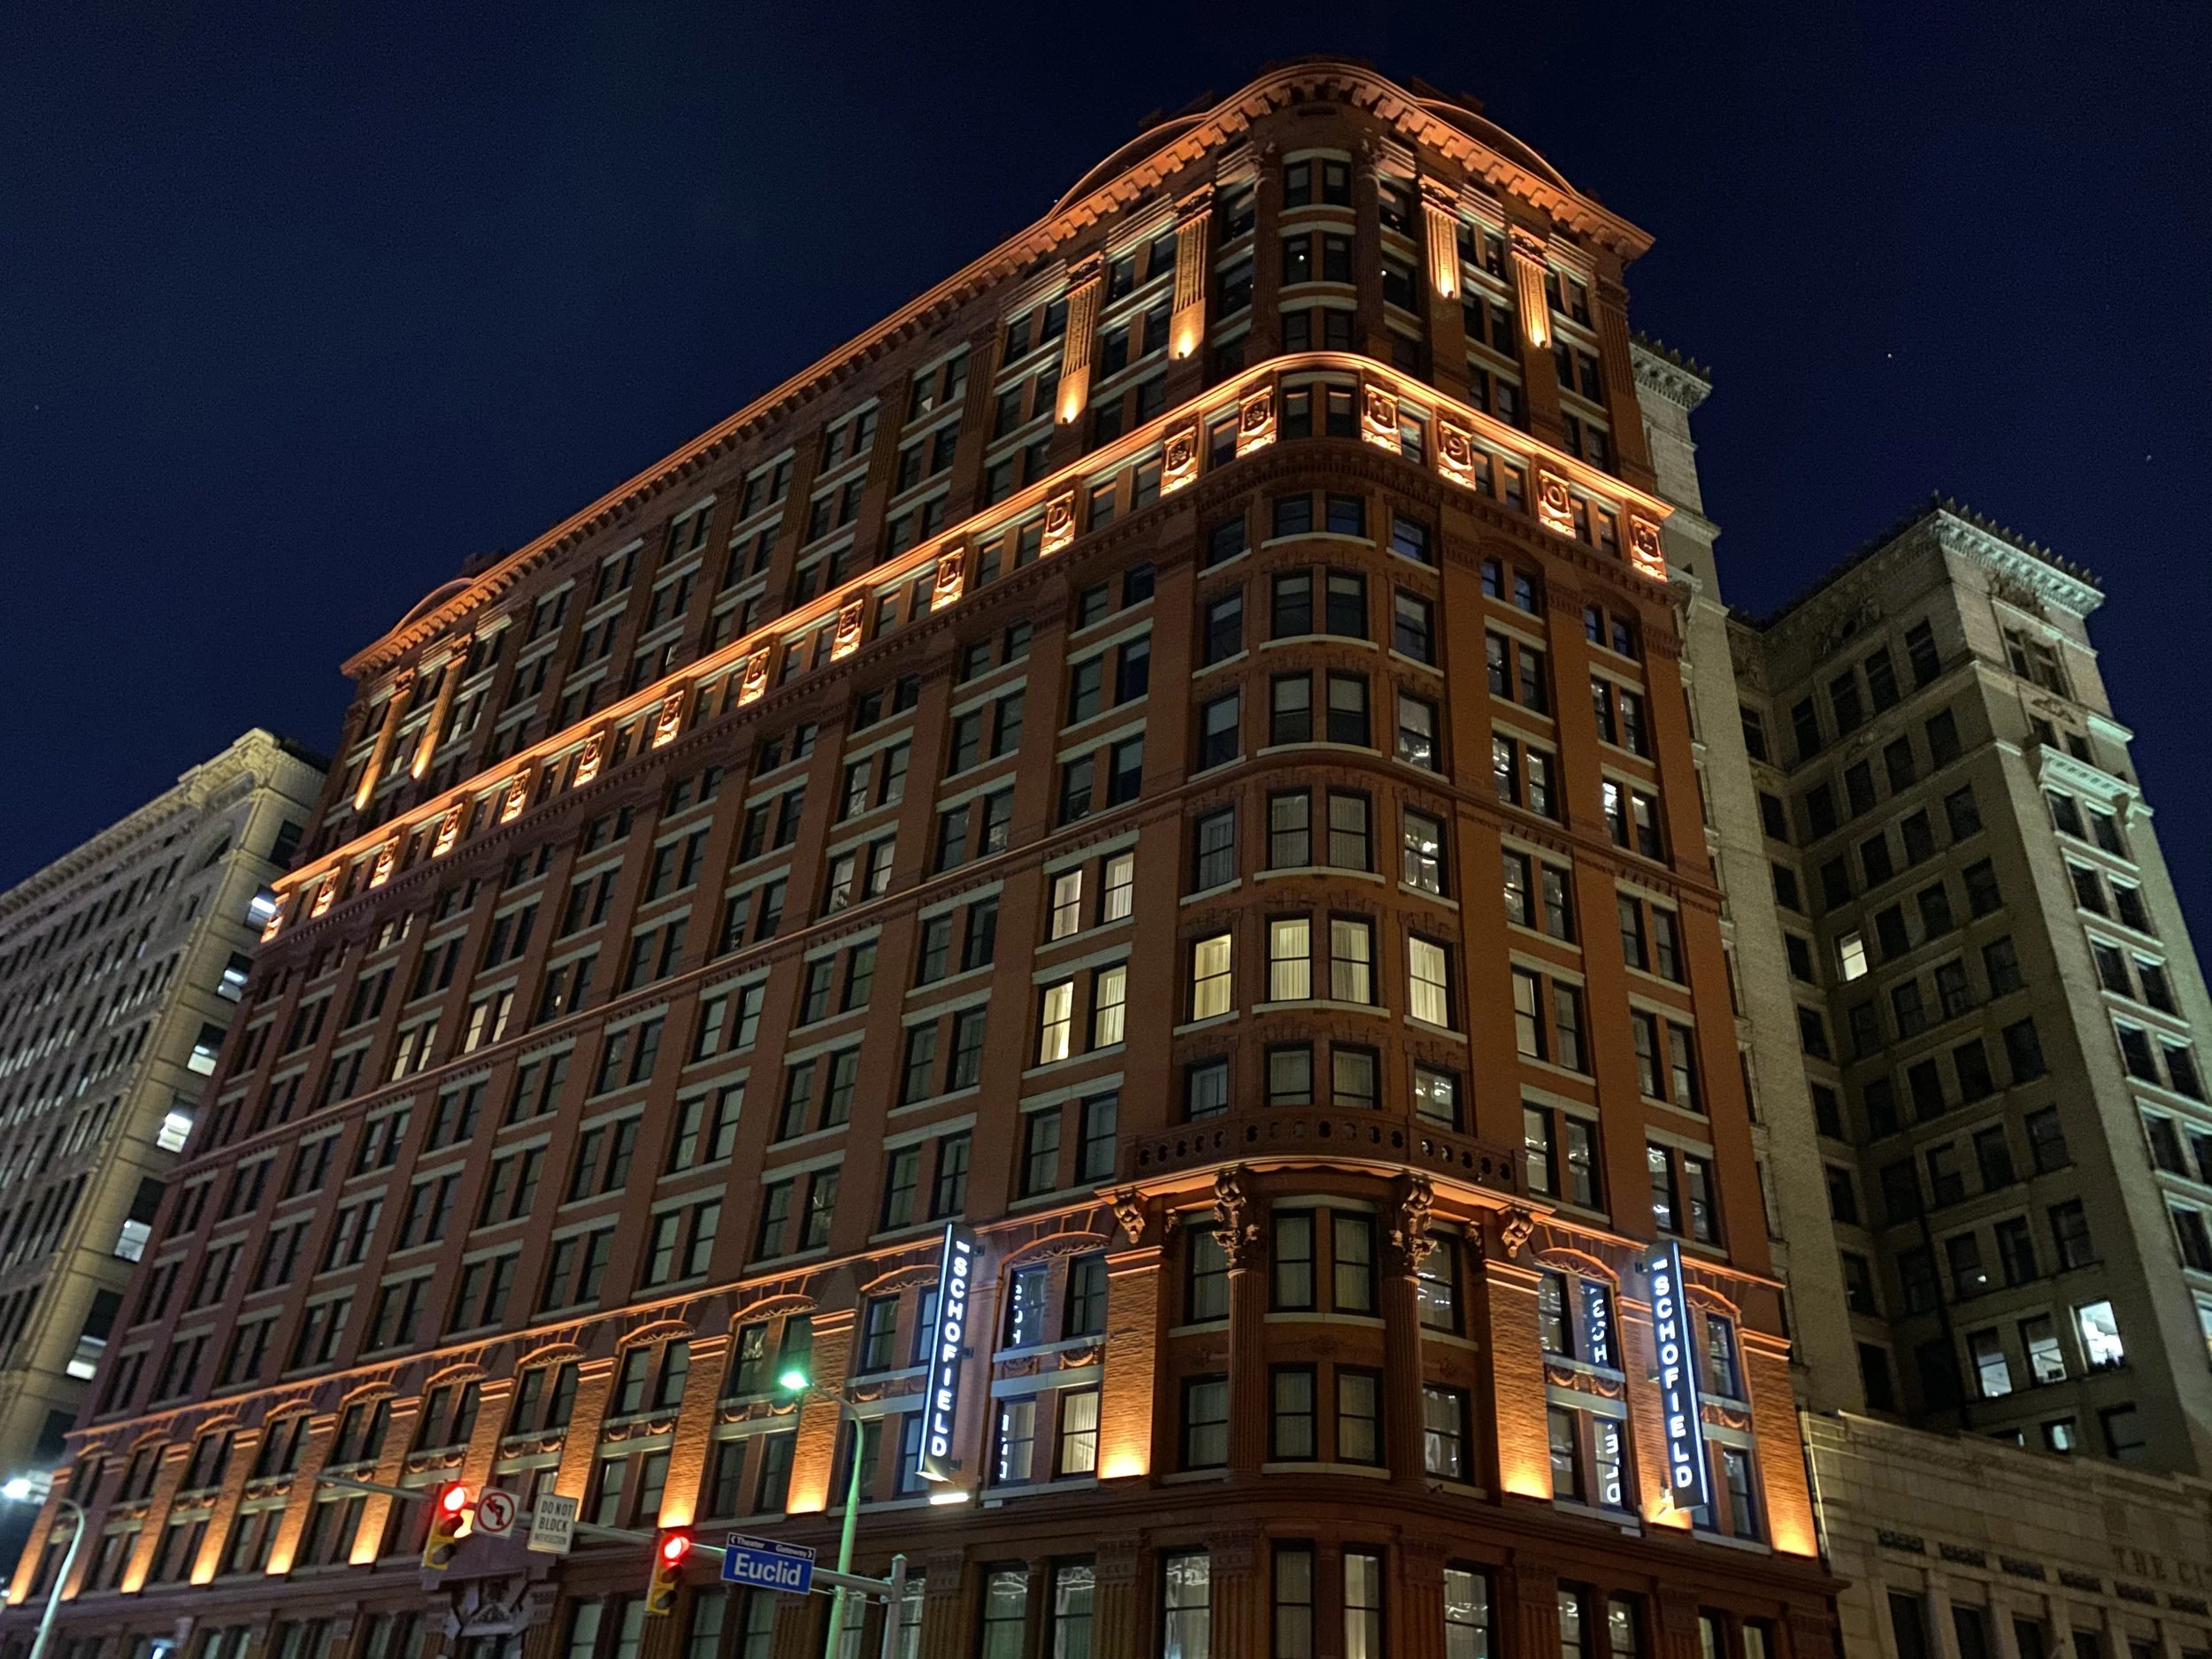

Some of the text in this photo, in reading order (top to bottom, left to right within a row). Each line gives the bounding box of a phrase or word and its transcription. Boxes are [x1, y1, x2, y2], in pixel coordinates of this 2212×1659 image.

[931, 1256, 968, 1457] SCHOFIELD
[1655, 1275, 1694, 1488] SCHOFIELD
[541, 1501, 573, 1517] DO NOT
[538, 1517, 568, 1532] BLOCK
[737, 1537, 808, 1558] Theater Gateway
[734, 1553, 802, 1586] Euclid
